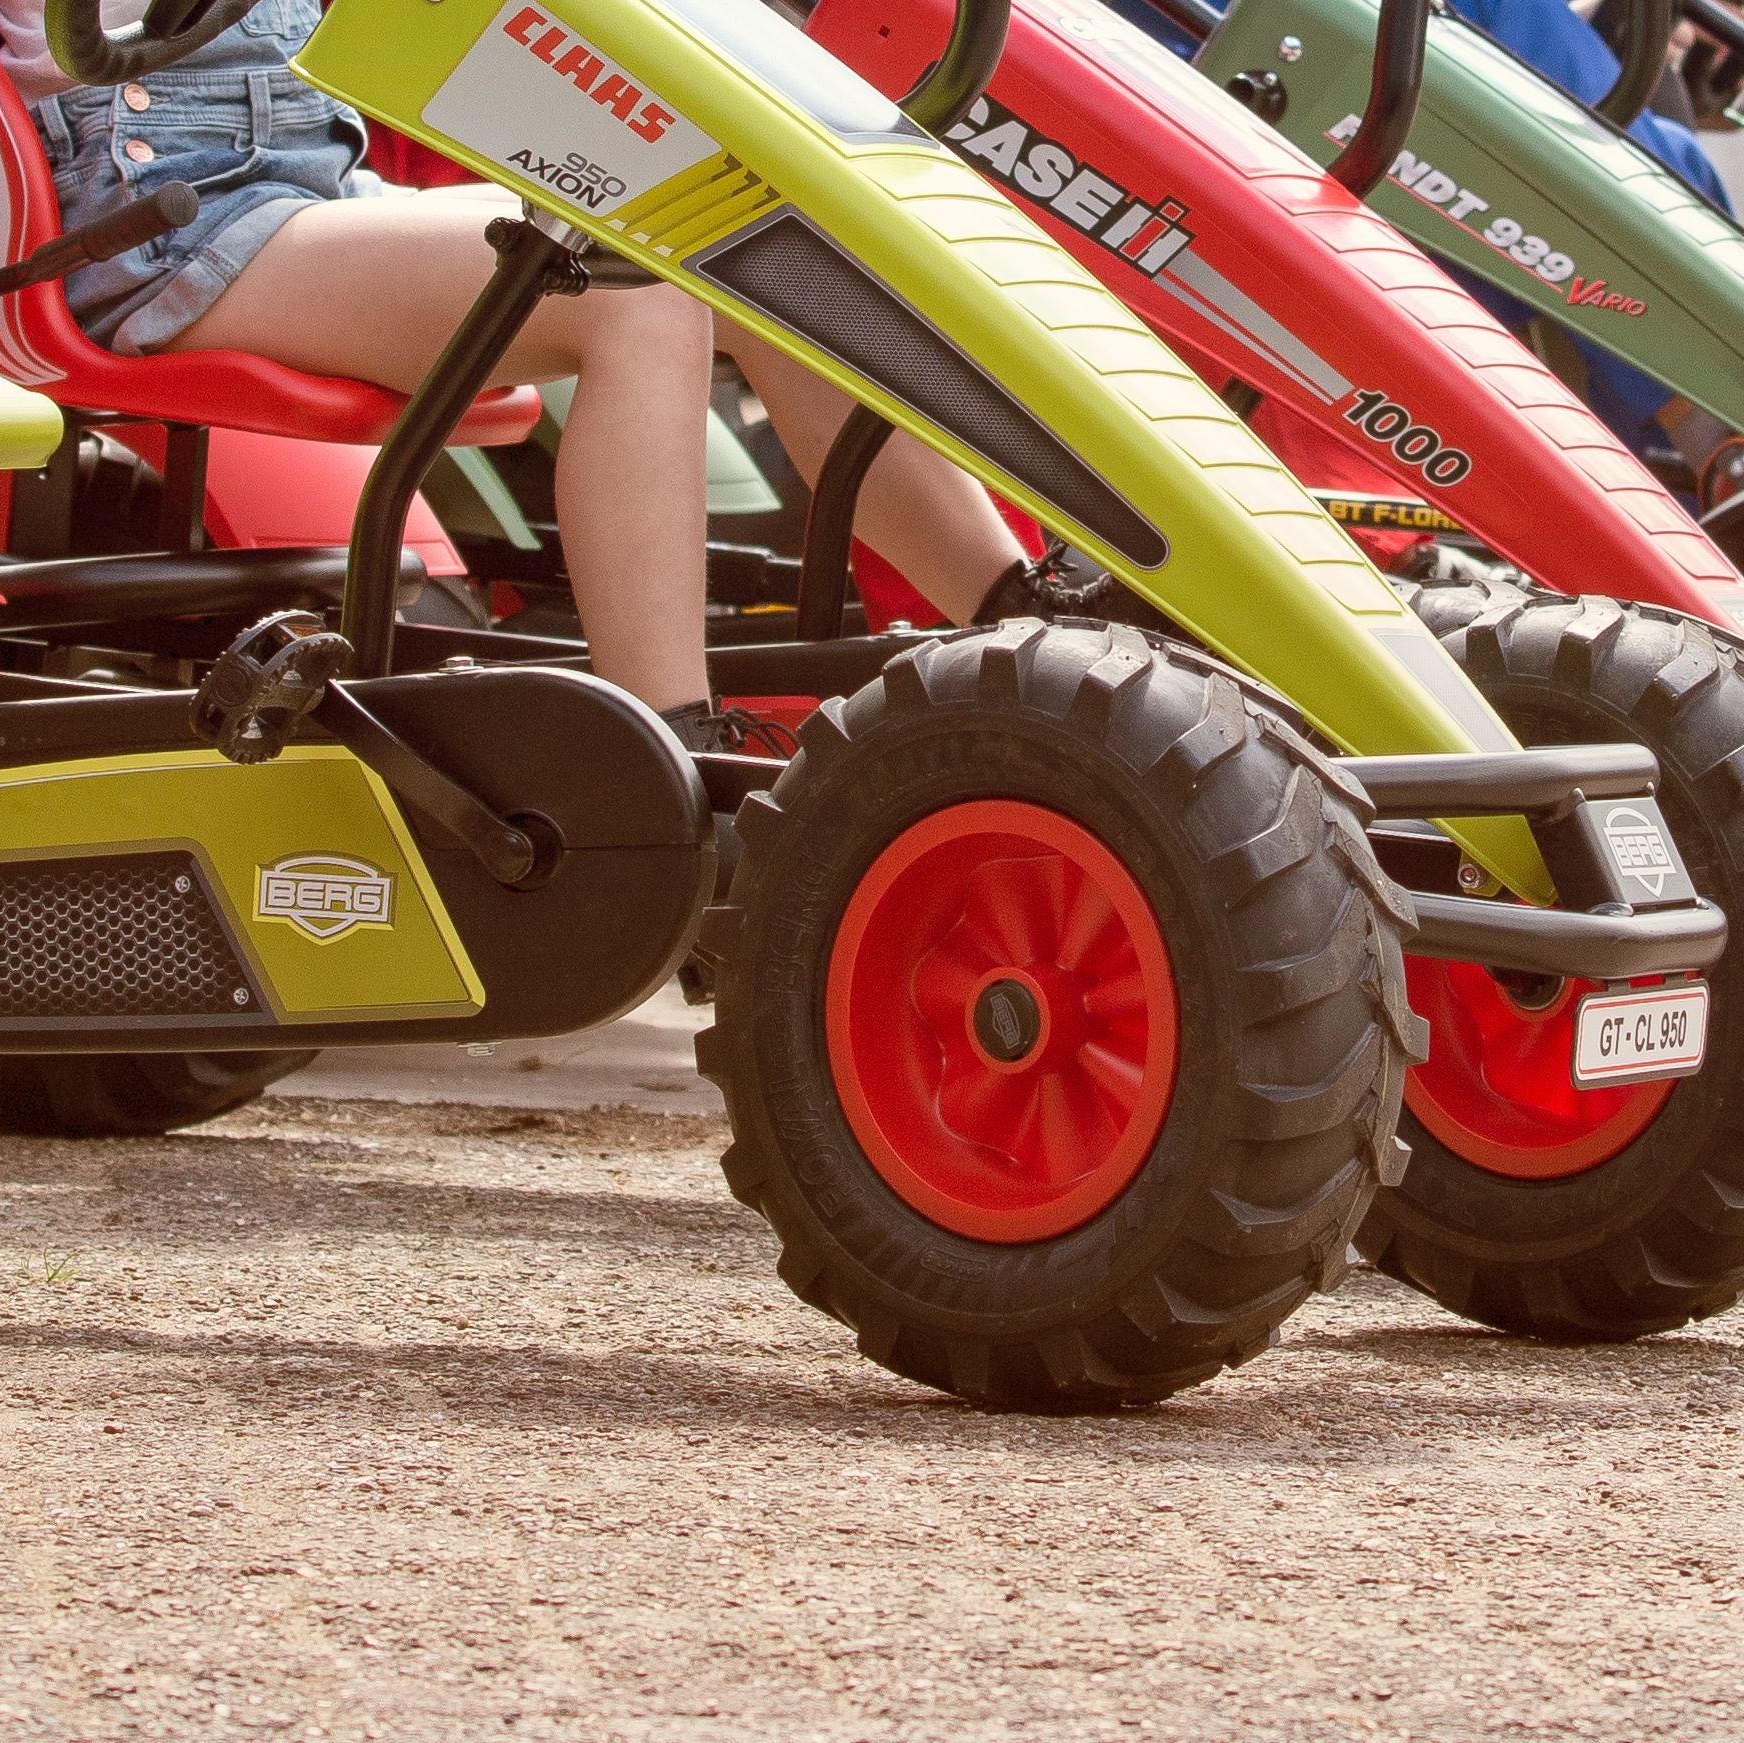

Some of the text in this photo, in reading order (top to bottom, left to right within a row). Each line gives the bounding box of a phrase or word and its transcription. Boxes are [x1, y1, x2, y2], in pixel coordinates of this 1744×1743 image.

[503, 6, 677, 144] CLAAS
[507, 148, 607, 209] AXION
[561, 152, 627, 198] 950
[1326, 112, 1490, 220] FNDT
[1484, 216, 1575, 282] 939
[1342, 388, 1472, 487] 1000
[1610, 834, 1671, 867] BERG
[267, 878, 383, 913] BERG
[1659, 1009, 1688, 1050] 950
